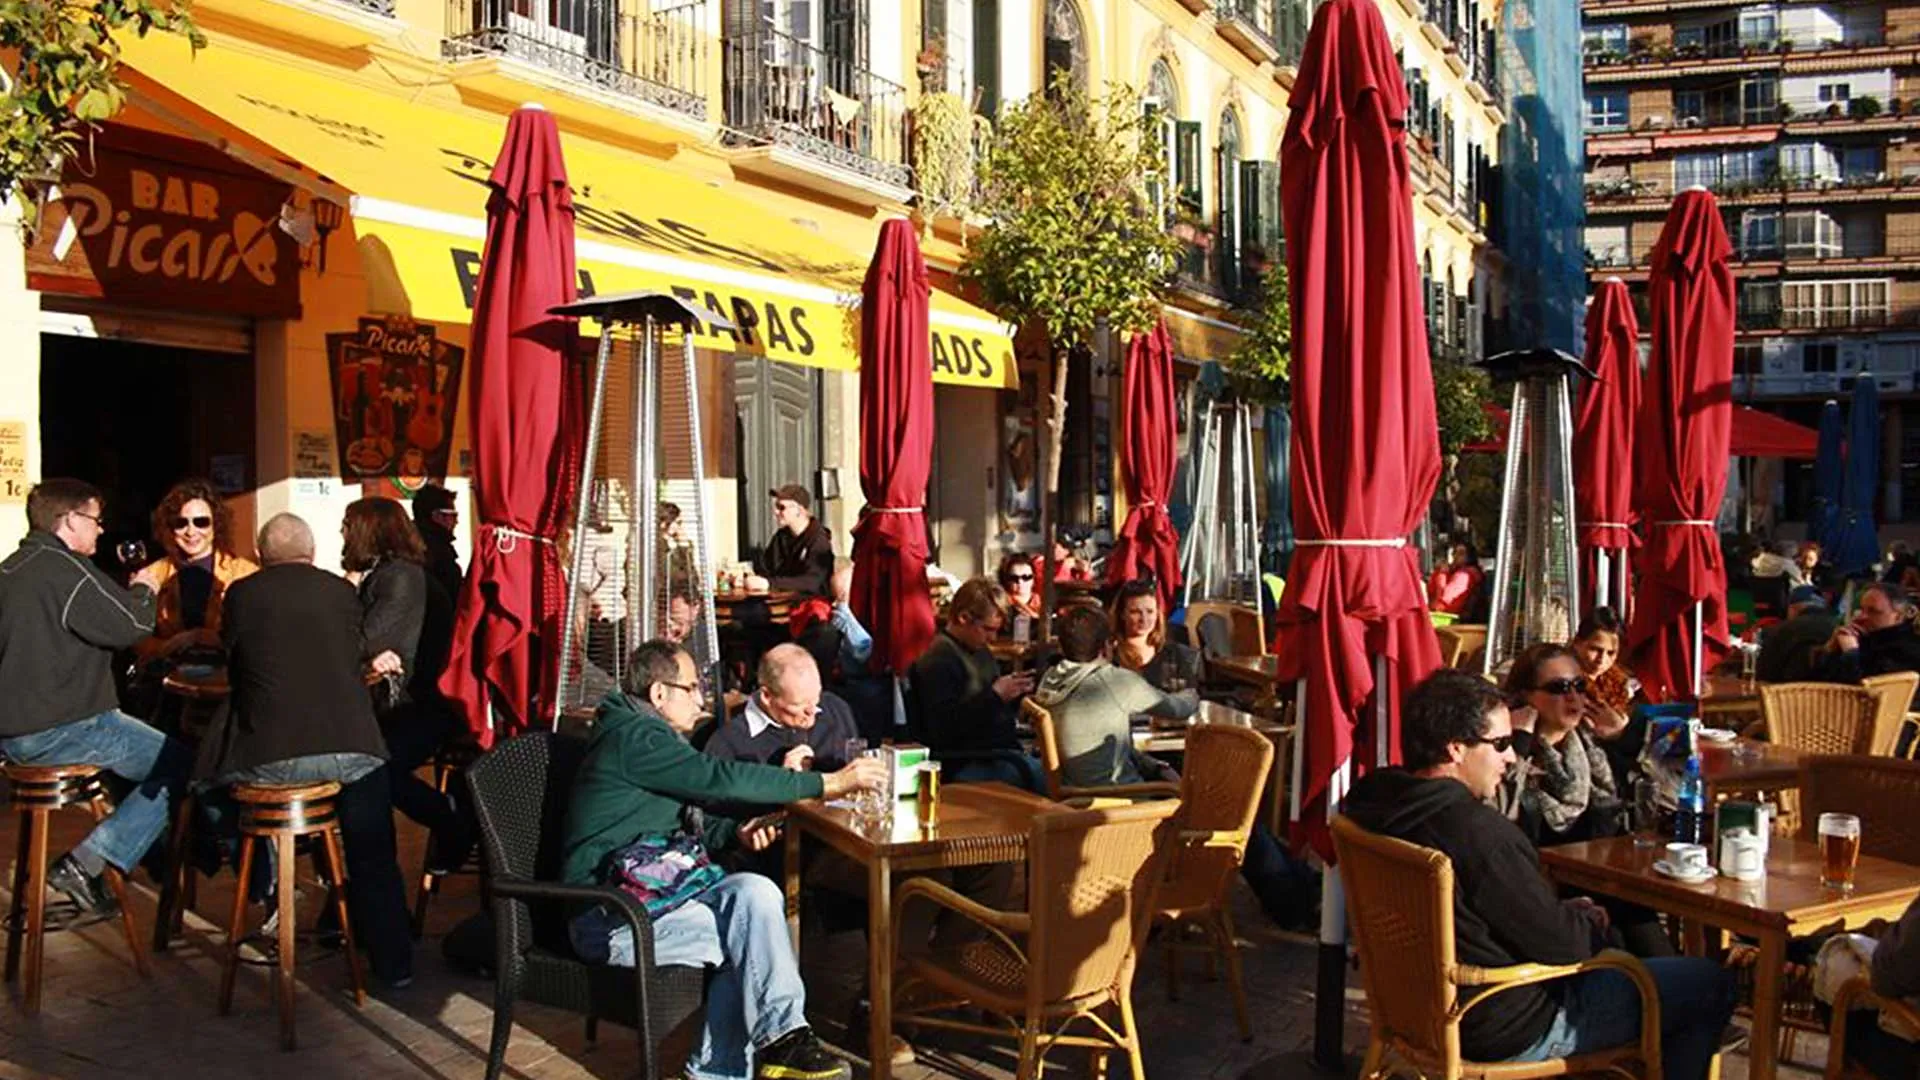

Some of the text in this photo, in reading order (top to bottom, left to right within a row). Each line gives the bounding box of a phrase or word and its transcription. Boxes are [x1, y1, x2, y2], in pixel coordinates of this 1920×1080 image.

[131, 169, 219, 221] BAR
[671, 285, 993, 379] TAPAS ADS
